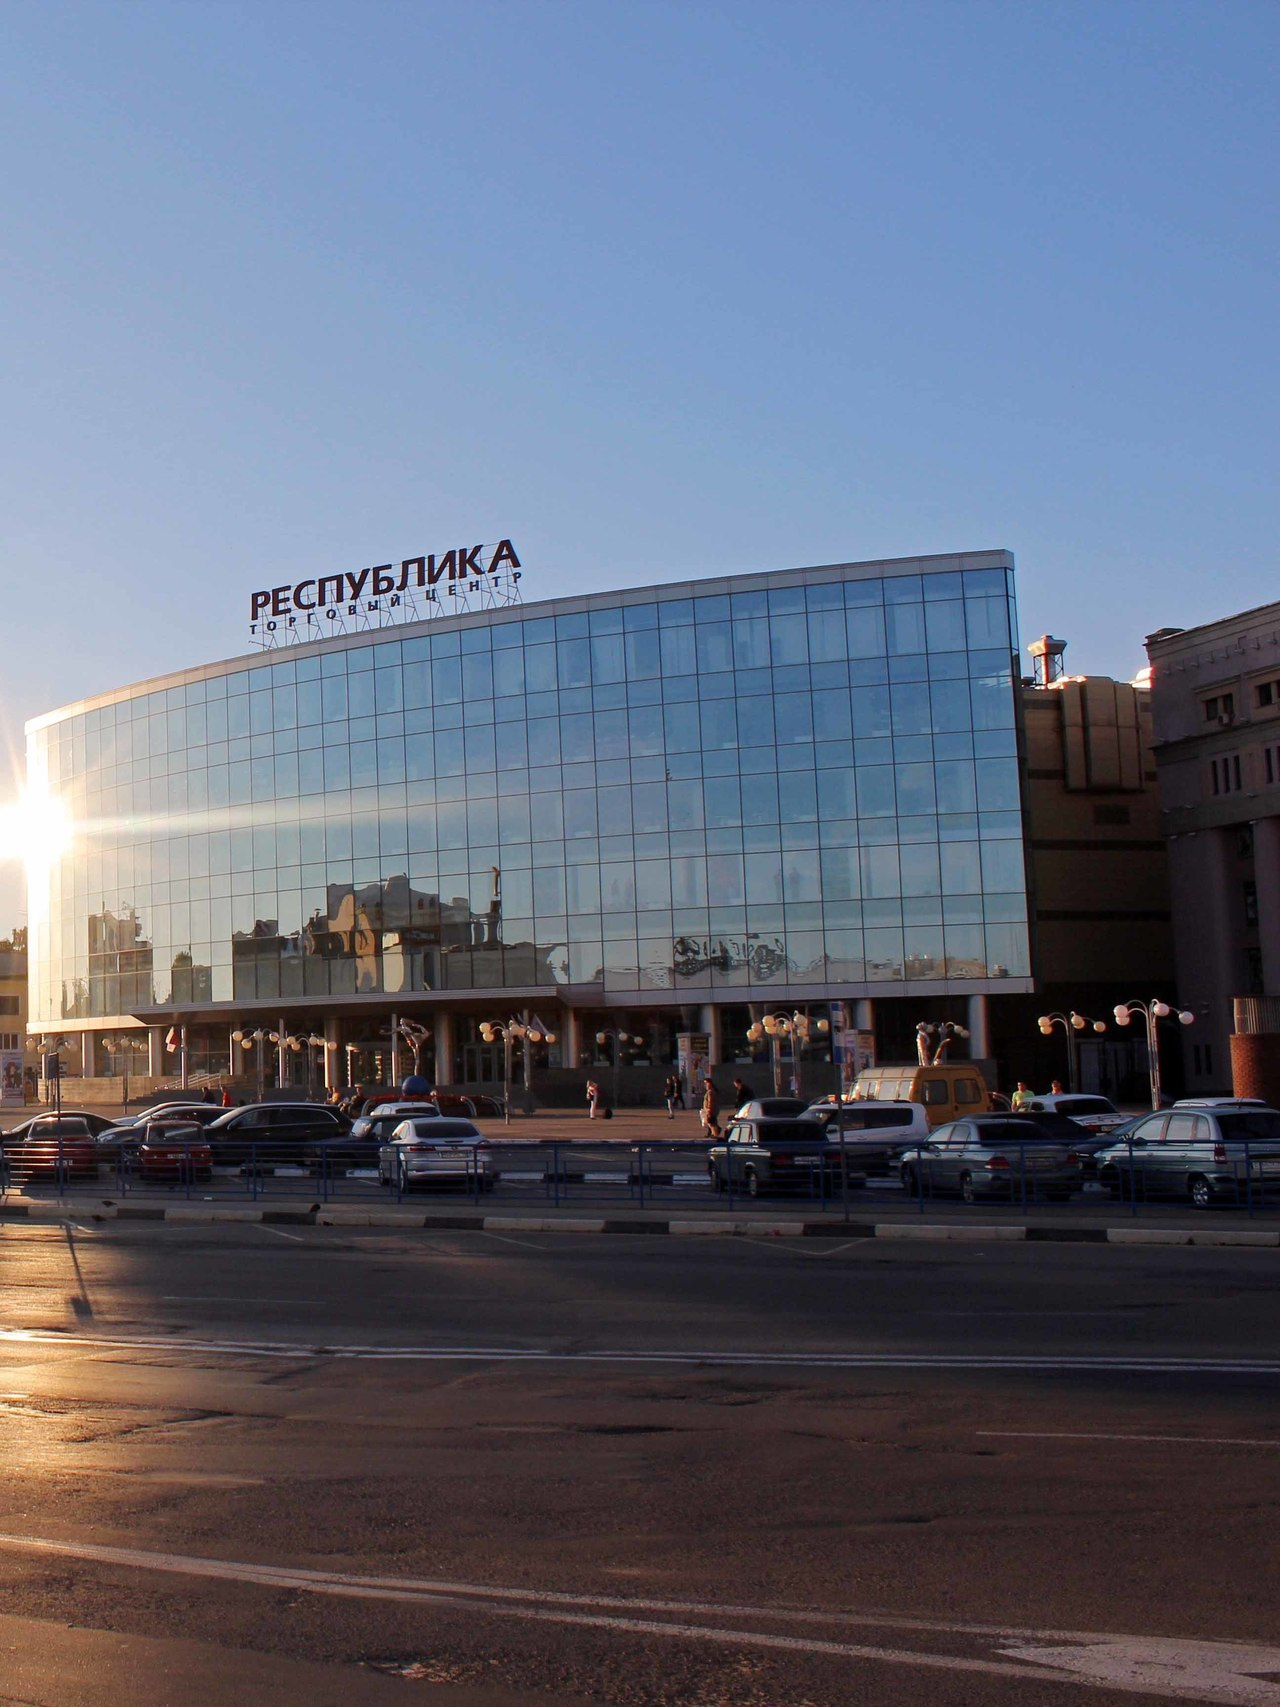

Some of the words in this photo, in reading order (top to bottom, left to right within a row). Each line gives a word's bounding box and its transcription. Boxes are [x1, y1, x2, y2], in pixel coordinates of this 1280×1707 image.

[249, 593, 401, 635] ТОРГОВЫЙ
[425, 572, 522, 602] ЦЕНТР
[250, 539, 521, 621] РЕСПУБЛИКА
